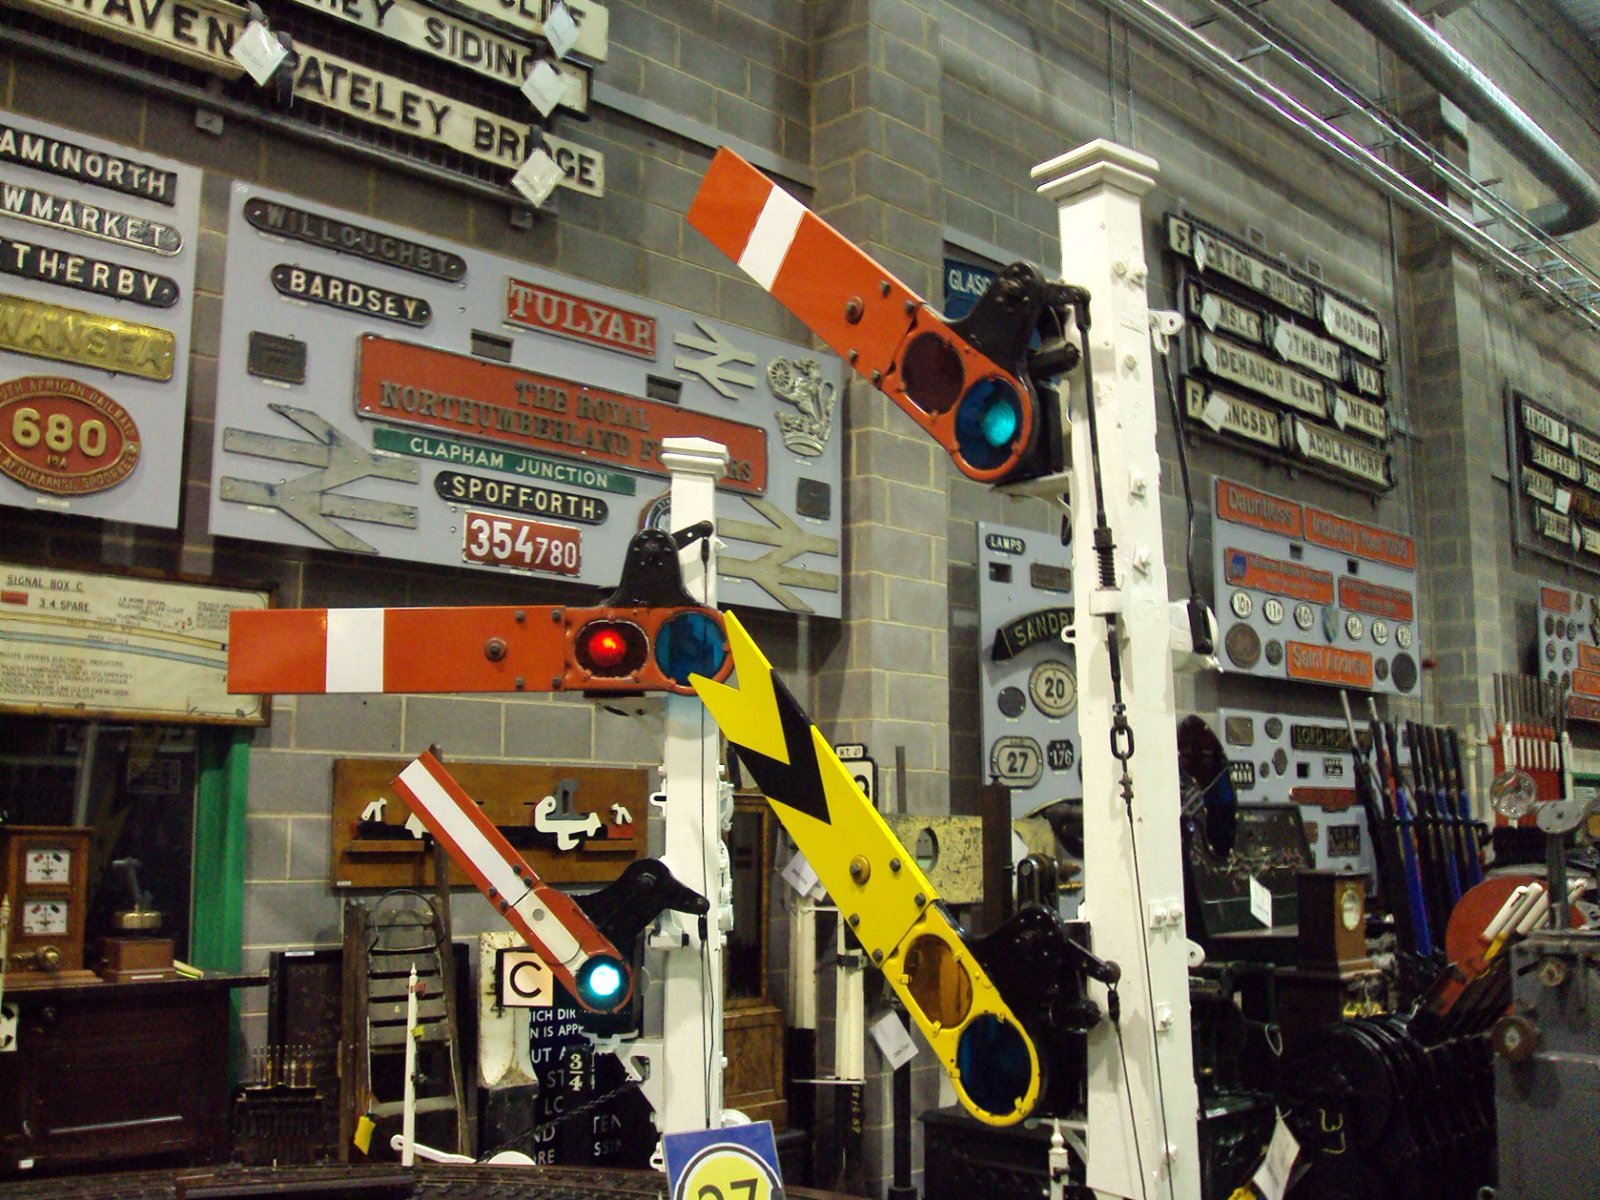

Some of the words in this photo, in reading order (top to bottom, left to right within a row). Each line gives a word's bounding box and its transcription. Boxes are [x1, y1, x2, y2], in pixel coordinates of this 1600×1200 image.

[266, 205, 452, 279] WILLOUGHBY
[290, 270, 417, 320] BARDSEY
[510, 282, 654, 353] TULYAR
[380, 380, 631, 458] NORTHUMBERLAND
[515, 378, 568, 414] THE
[577, 392, 649, 432] ROYAL
[12, 407, 107, 457] 680
[409, 437, 504, 469] CLAPHAM
[515, 457, 609, 488] JUNCTION
[452, 475, 596, 521] SPOFFORTH
[1229, 486, 1293, 526] Dauntless
[990, 533, 1023, 552] LAMPS
[7, 575, 43, 589] SIGNAL
[51, 579, 70, 592] BOX
[60, 600, 90, 613] SPARE
[1293, 645, 1323, 671] Saint
[1044, 676, 1065, 700] 20
[1007, 751, 1029, 774] 27
[1052, 750, 1072, 766] 176
[510, 961, 542, 999] C
[543, 1026, 554, 1038] IS
